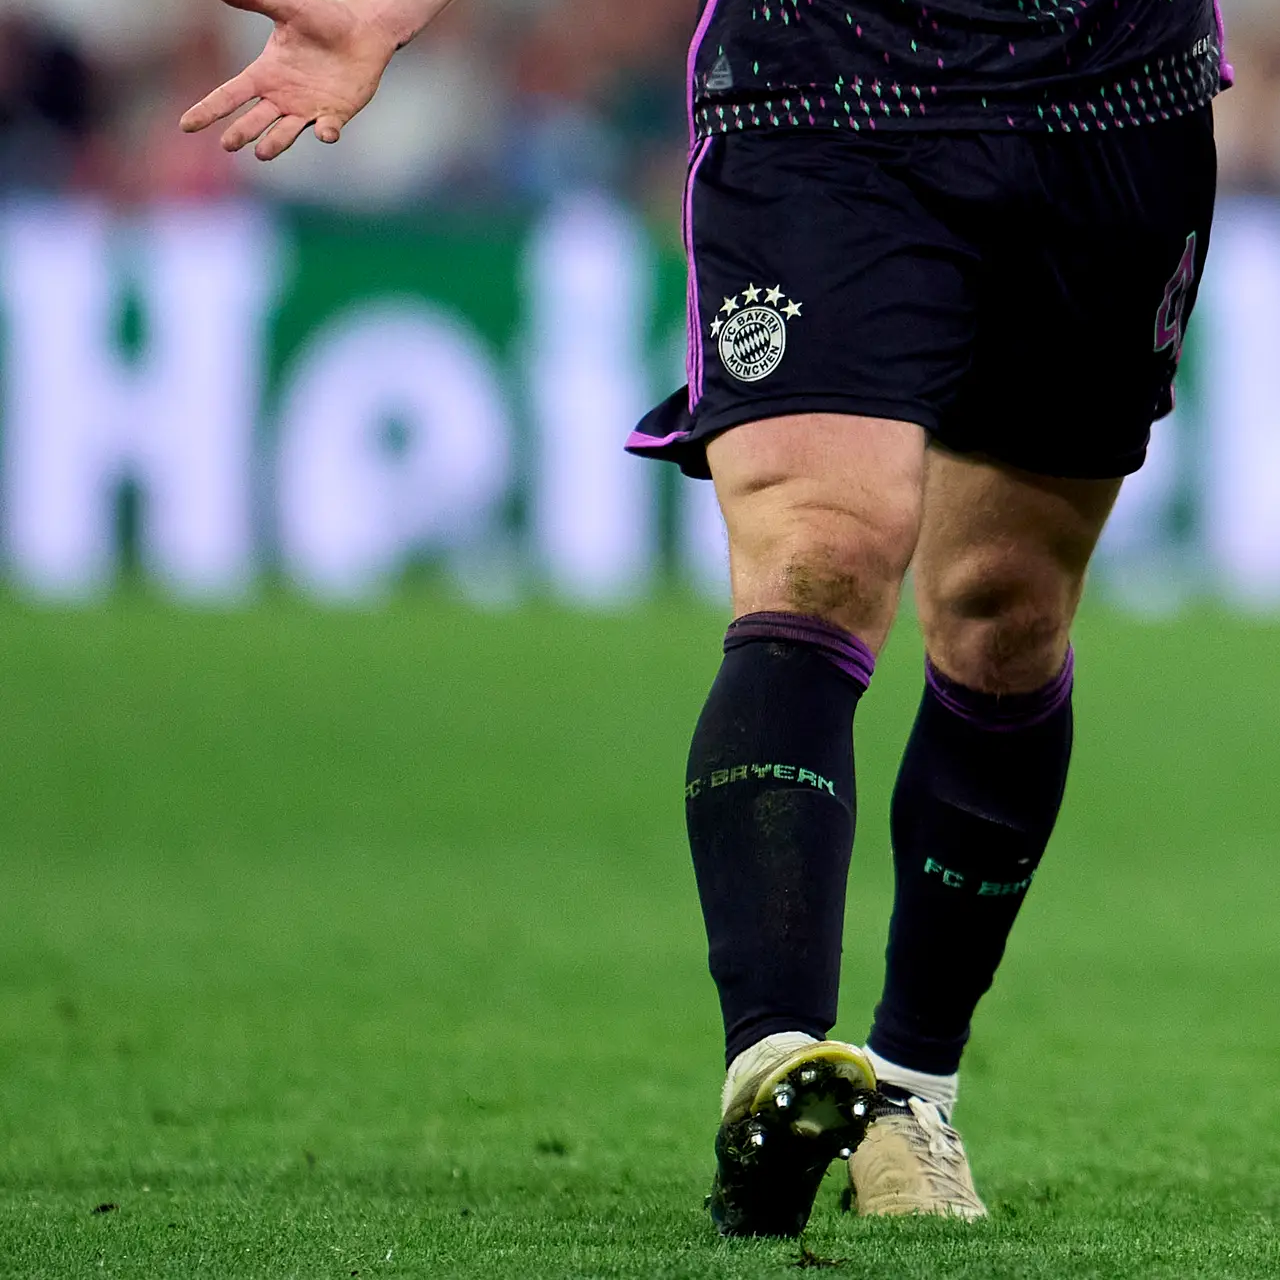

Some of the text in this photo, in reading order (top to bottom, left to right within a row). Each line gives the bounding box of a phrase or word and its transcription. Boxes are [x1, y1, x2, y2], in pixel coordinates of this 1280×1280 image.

[725, 311, 780, 343] FC BAYERN
[727, 345, 780, 376] MÜNCHEN
[711, 764, 836, 797] BAYERN
[924, 857, 964, 888] FC
